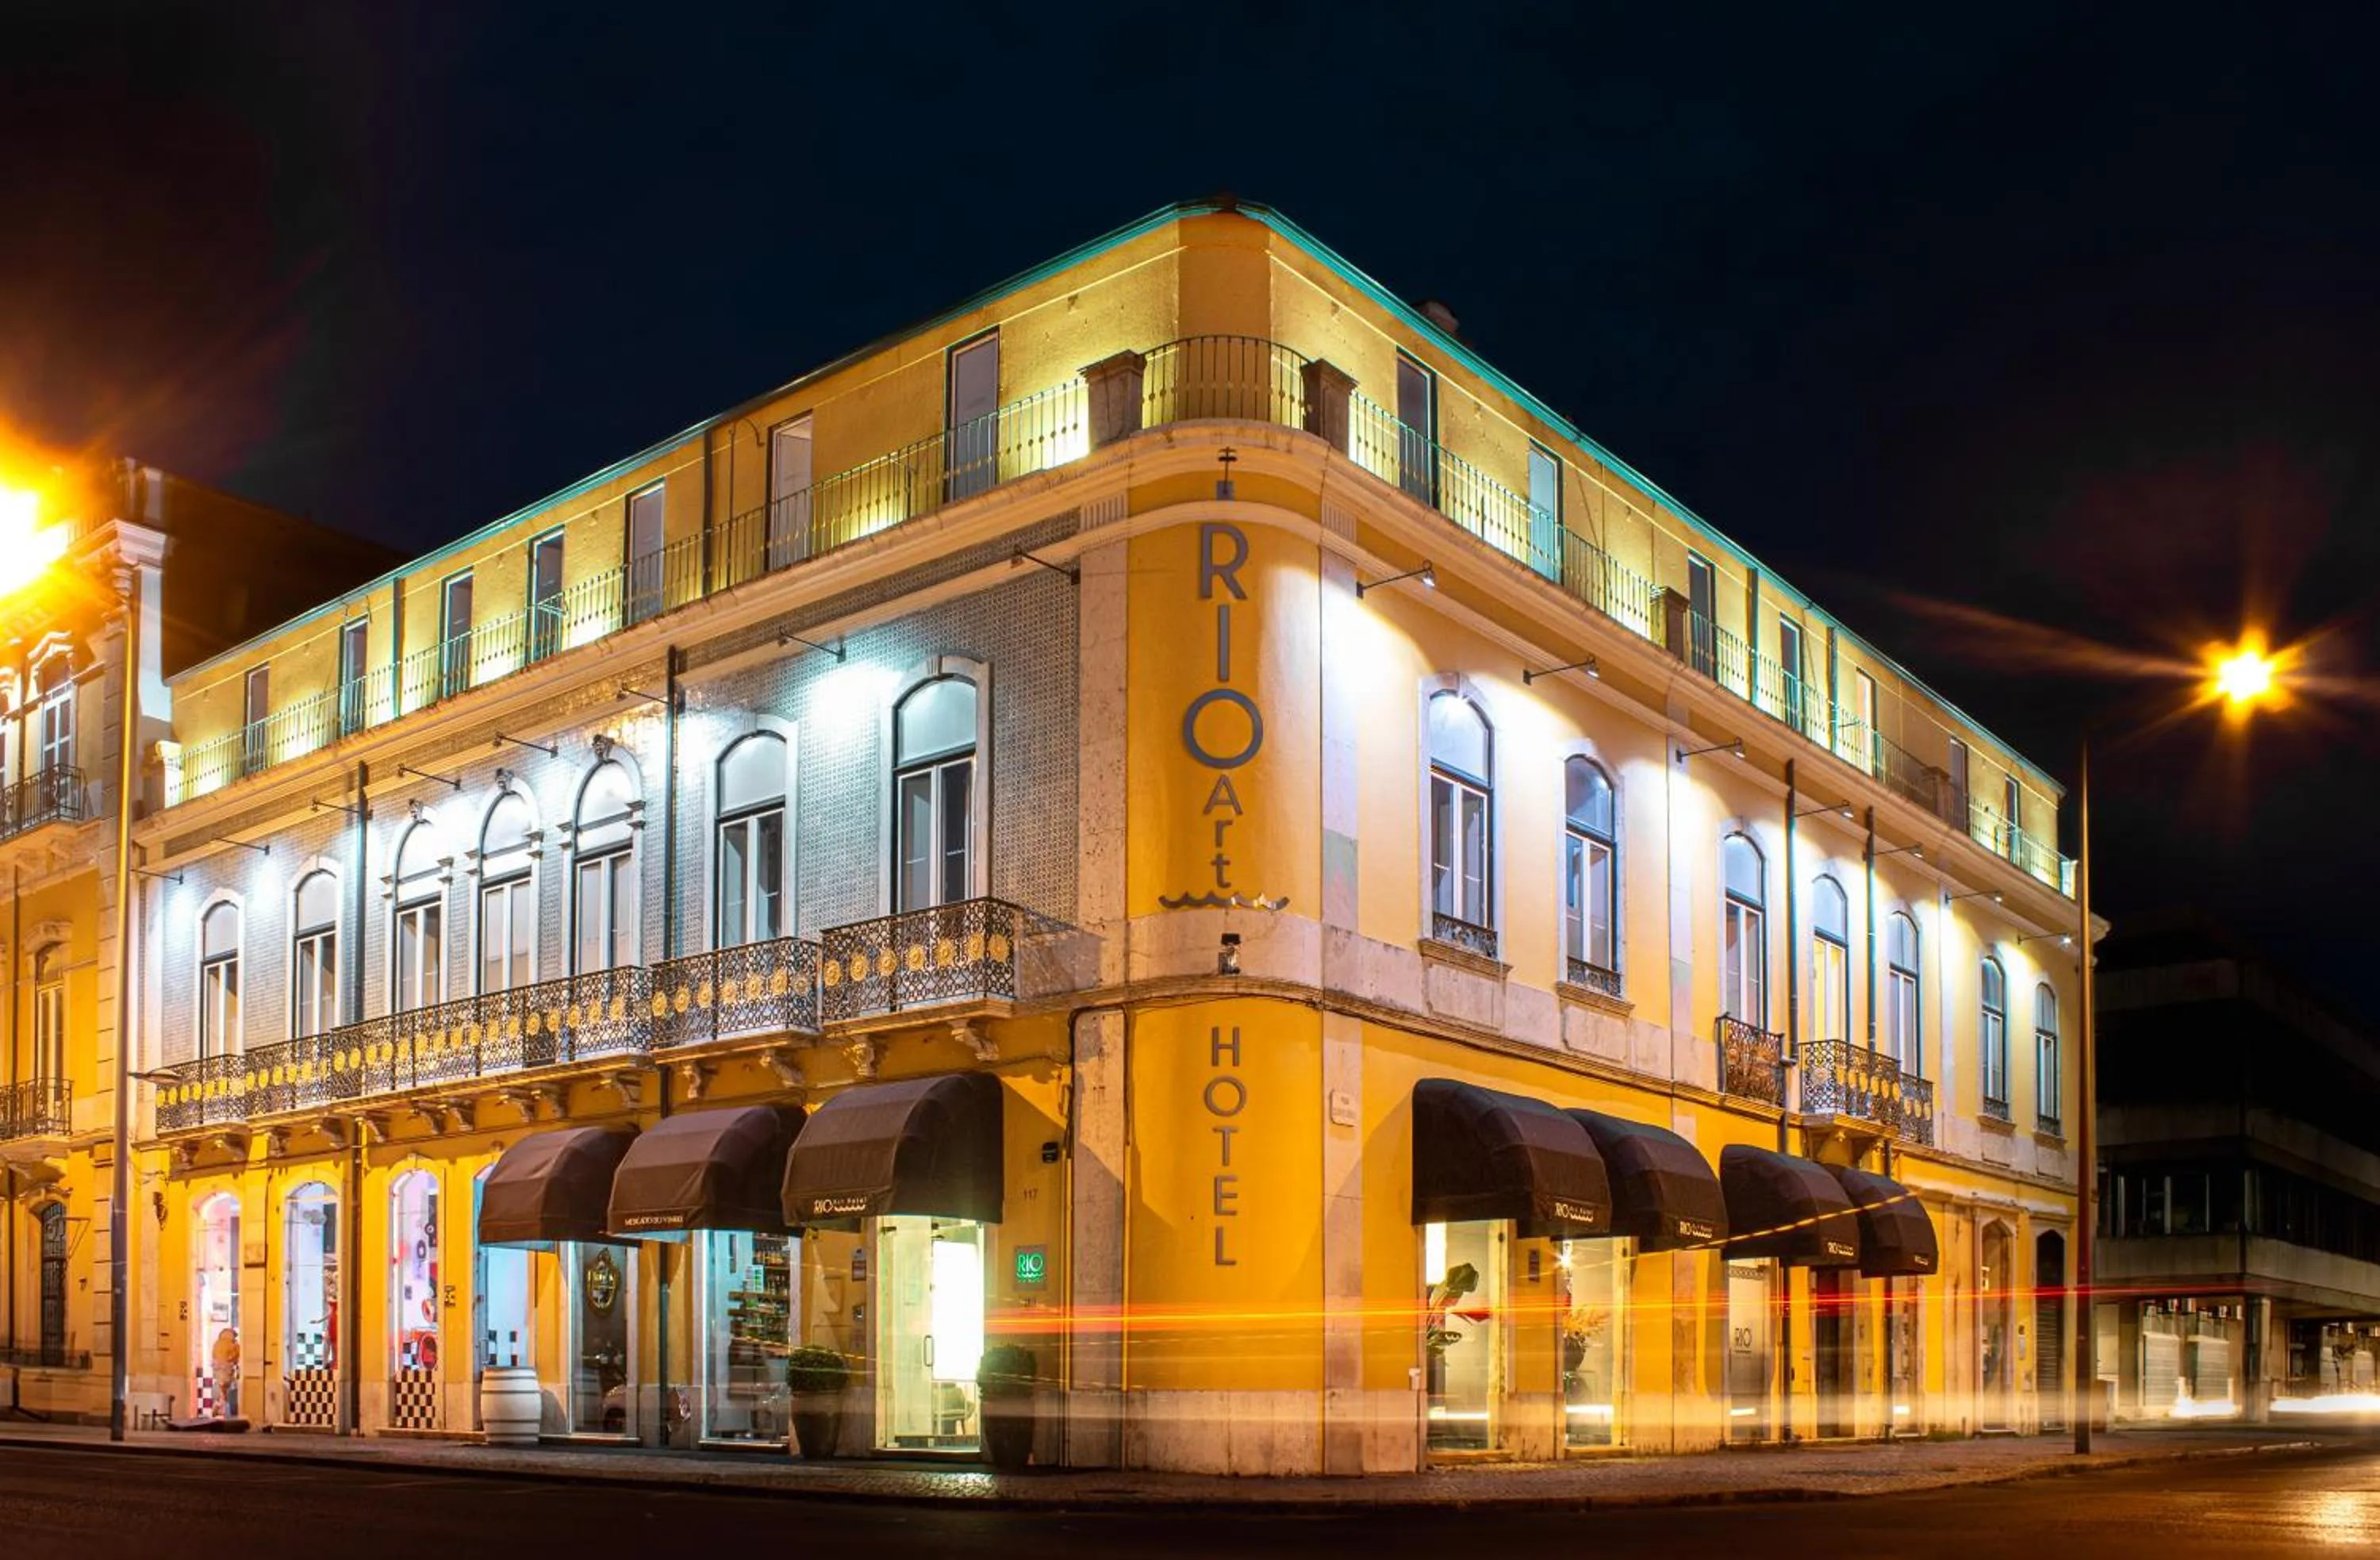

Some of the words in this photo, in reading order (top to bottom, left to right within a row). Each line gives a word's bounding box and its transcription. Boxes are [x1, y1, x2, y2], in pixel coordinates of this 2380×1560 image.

[1182, 523, 1263, 769] RIO
[1203, 774, 1243, 889] Art
[1203, 1026, 1247, 1266] HOTEL
[813, 1199, 833, 1213] RIO
[1016, 1253, 1043, 1272] RIO
